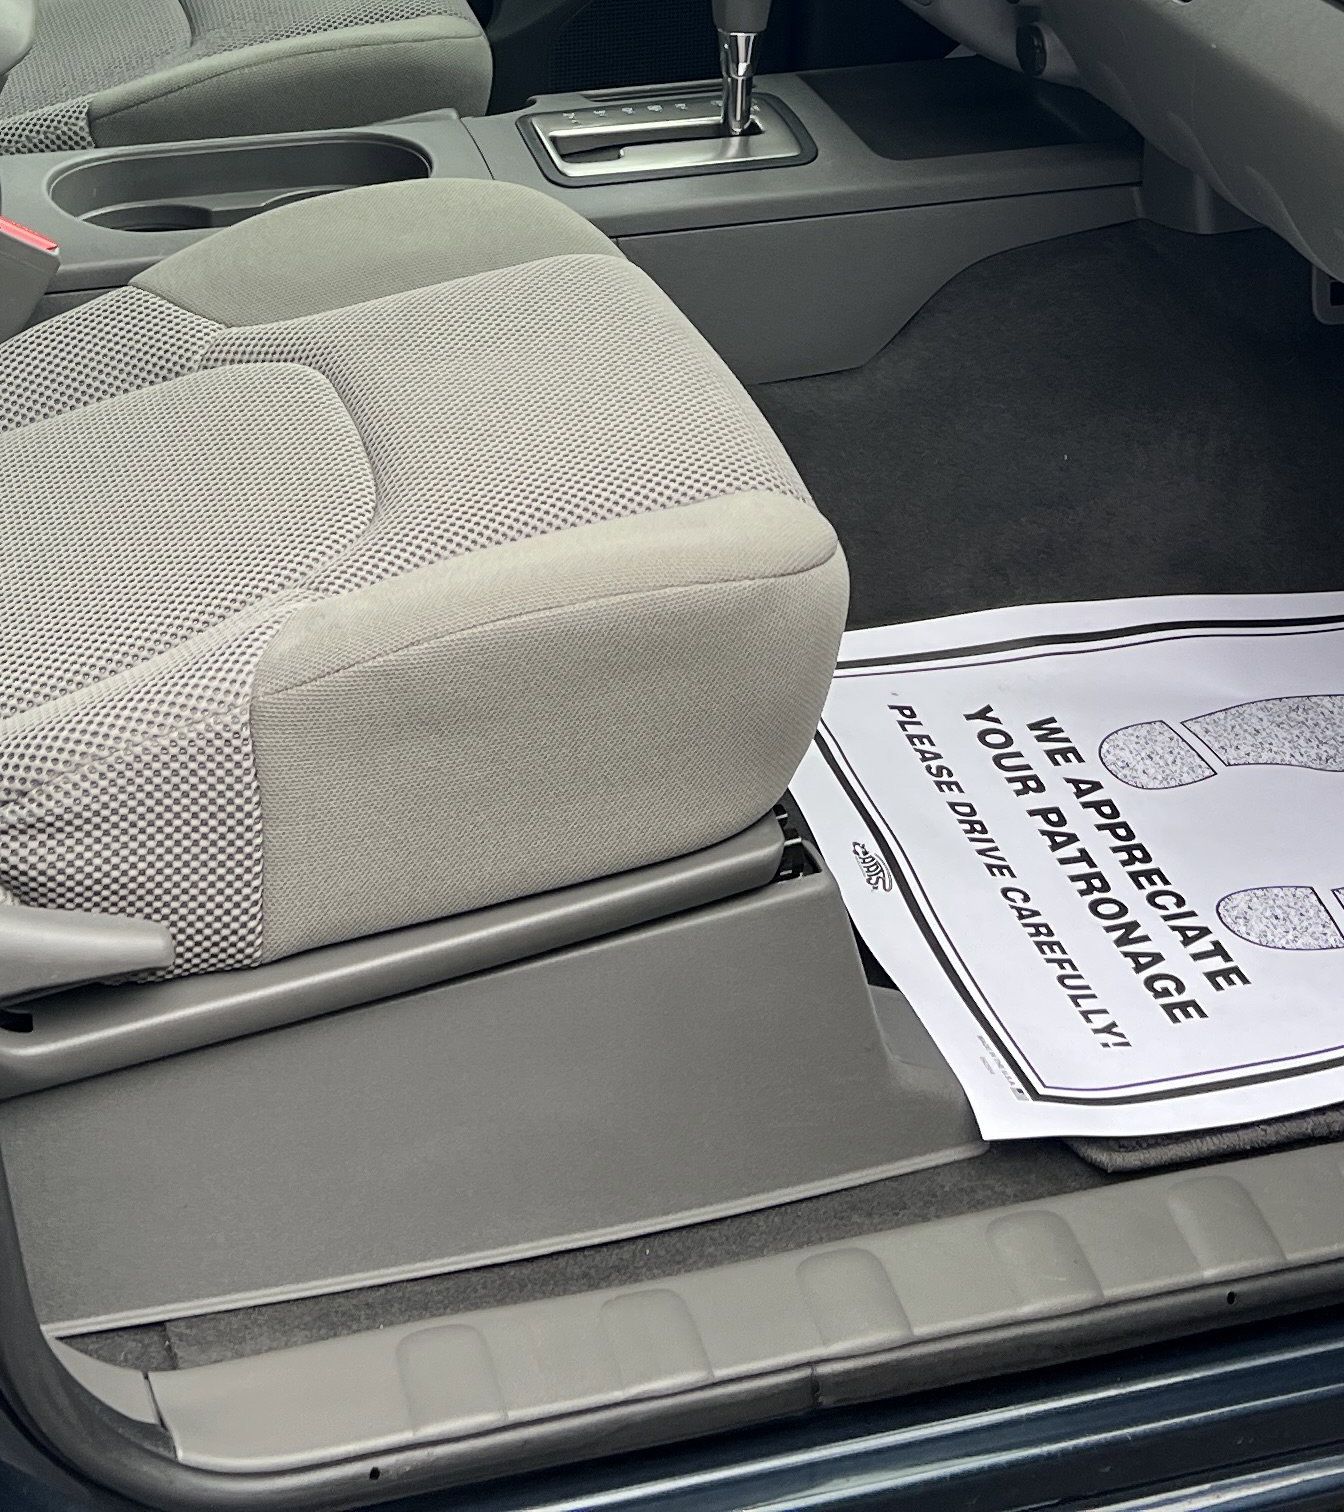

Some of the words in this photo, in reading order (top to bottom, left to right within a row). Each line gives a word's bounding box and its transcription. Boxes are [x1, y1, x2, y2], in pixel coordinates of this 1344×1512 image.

[887, 704, 965, 794] PLEASE
[946, 800, 1018, 879] DRIVE
[1000, 886, 1133, 1049] CAREFULLY!
[963, 703, 1046, 798] YOUR
[1026, 806, 1209, 1025] PATRONAGE
[1026, 716, 1086, 767] WE
[1063, 777, 1253, 992] APPRECIATE
